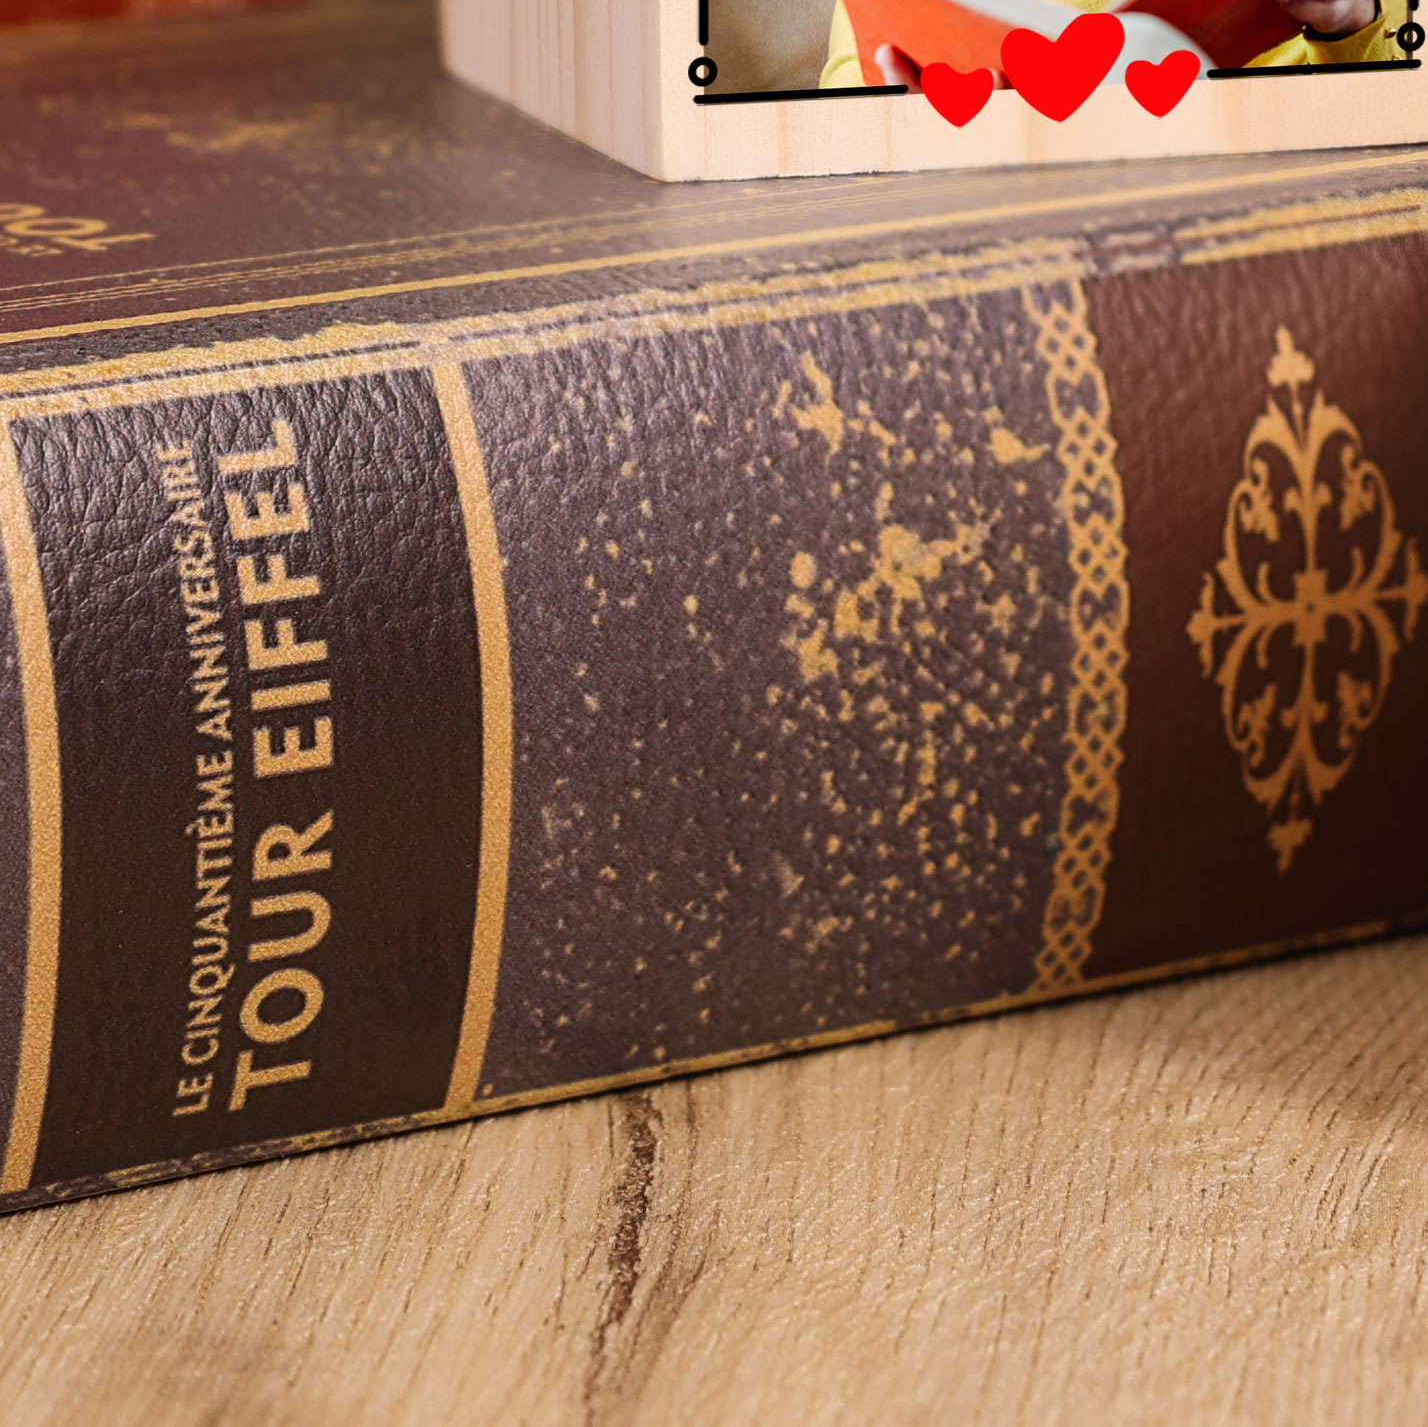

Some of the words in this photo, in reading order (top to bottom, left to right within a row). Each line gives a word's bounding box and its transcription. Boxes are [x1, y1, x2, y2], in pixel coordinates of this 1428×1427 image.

[156, 438, 233, 742] ANNIVERSAIRE
[217, 419, 334, 778] EIFFEL
[182, 749, 236, 1066] CINQUANTIÈME
[228, 808, 334, 1112] TOUR
[173, 1073, 213, 1117] LE
